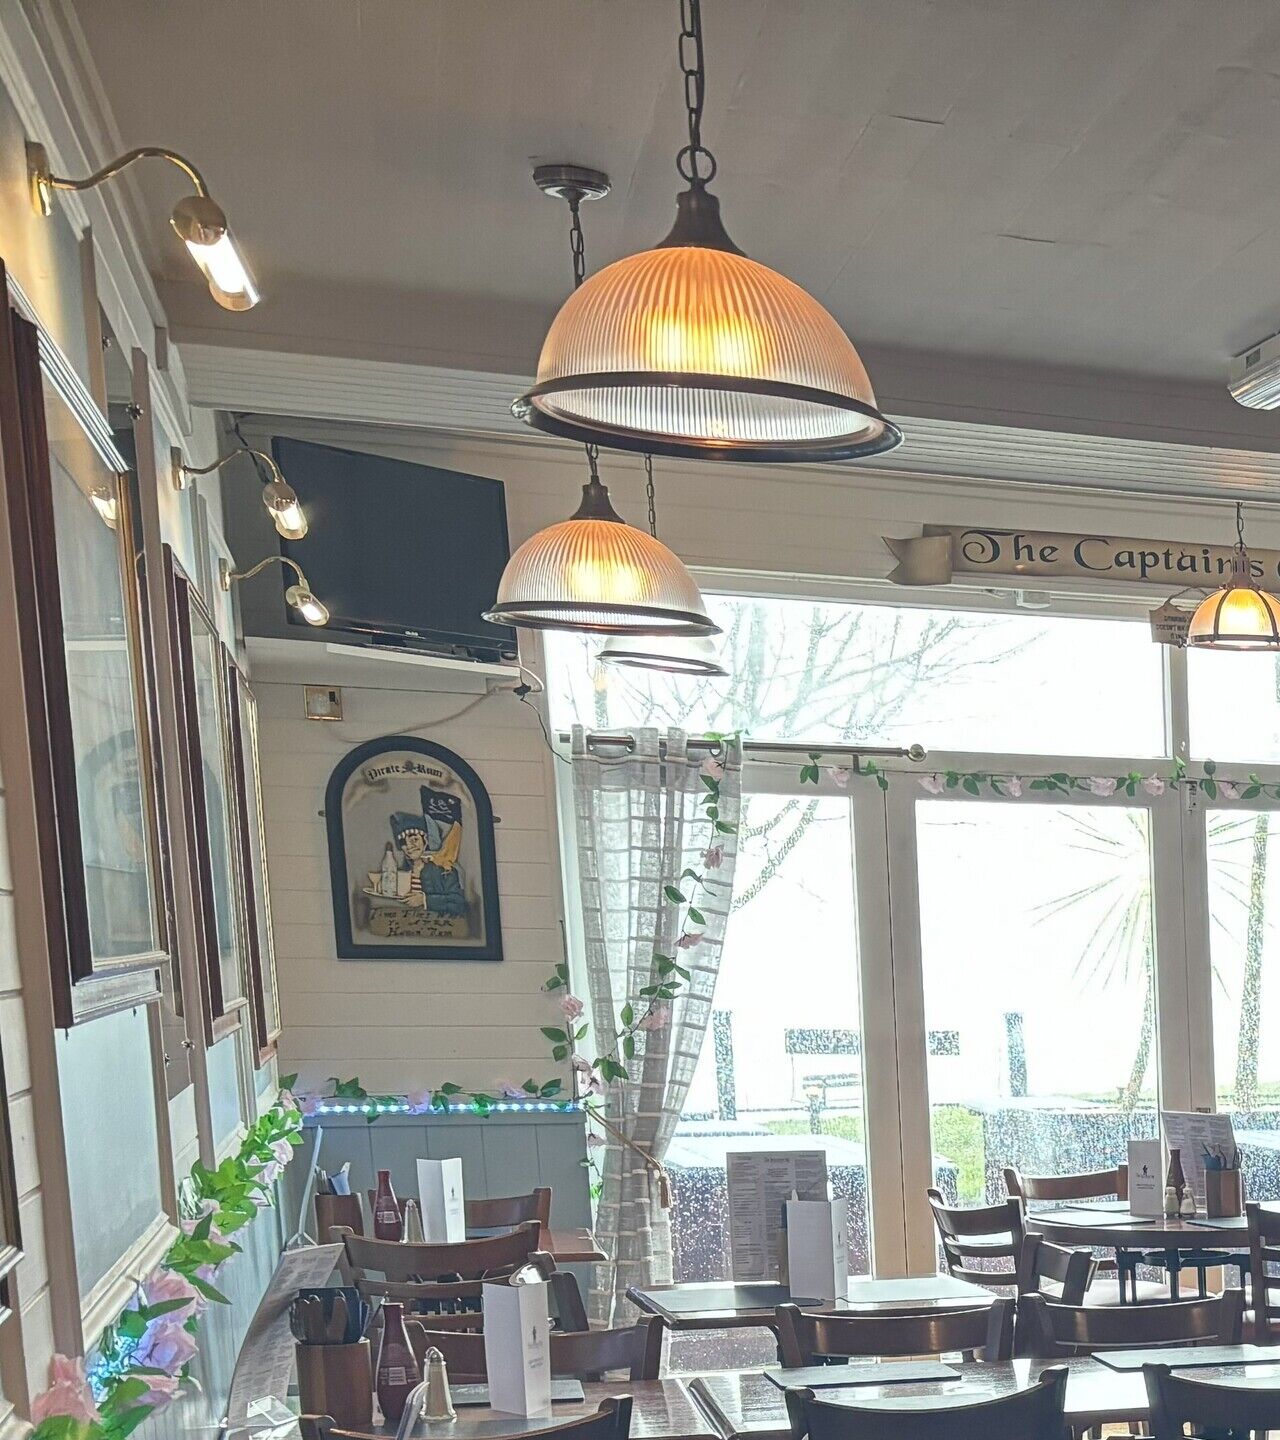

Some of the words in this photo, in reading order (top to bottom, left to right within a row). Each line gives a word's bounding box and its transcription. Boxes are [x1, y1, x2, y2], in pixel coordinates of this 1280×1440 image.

[960, 529, 1059, 564] The
[368, 765, 400, 780] Pirate
[417, 763, 443, 778] Rum
